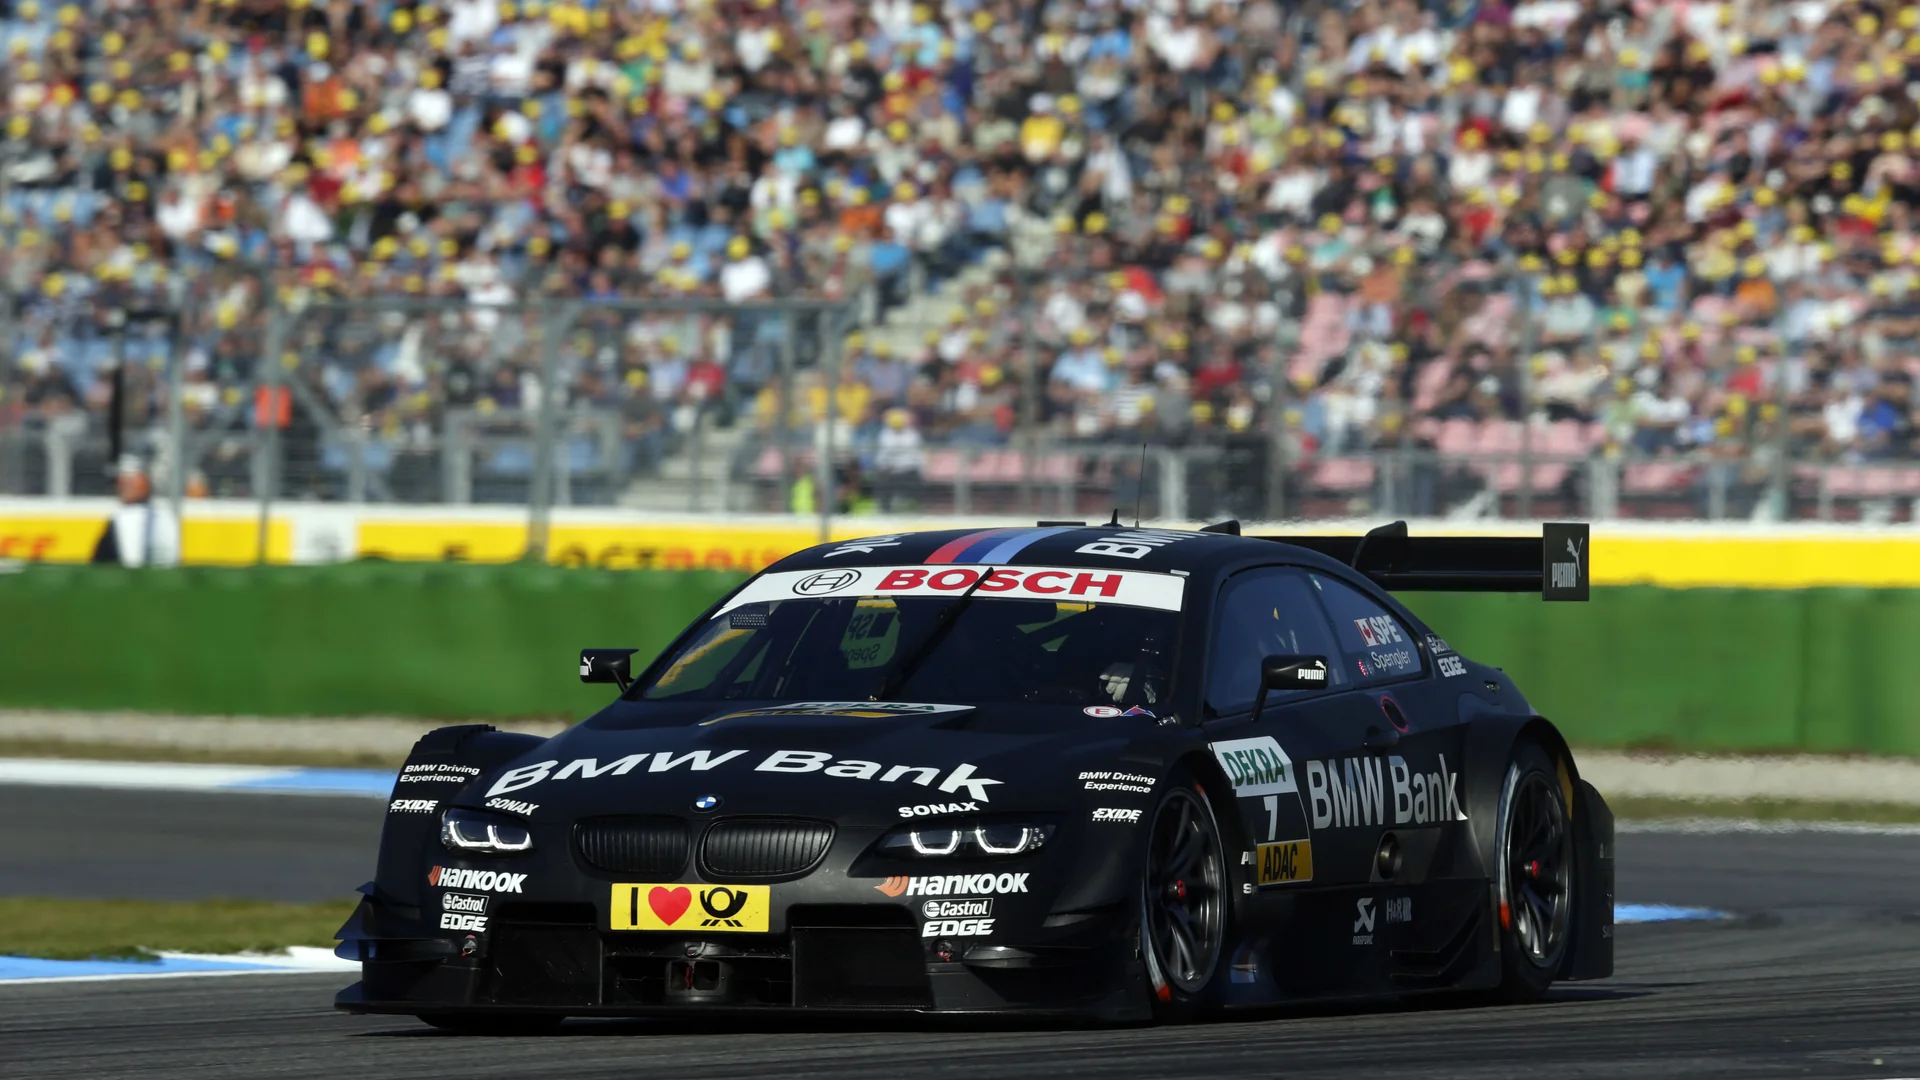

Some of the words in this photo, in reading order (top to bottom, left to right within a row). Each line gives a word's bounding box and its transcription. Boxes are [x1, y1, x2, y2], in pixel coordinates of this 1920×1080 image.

[875, 568, 1122, 597] BOSCH
[1552, 563, 1576, 588] PUMA
[1369, 614, 1402, 645] SPE
[1371, 648, 1412, 672] Spengler
[1437, 656, 1467, 677] EDGE
[1298, 669, 1324, 680] PUMA
[404, 764, 437, 774] BMW
[438, 765, 480, 776] Driving
[485, 749, 749, 798] BMW
[754, 750, 1005, 803] Bank
[1222, 746, 1287, 787] DEKRA
[400, 774, 465, 783] Experience
[1078, 772, 1112, 780] BMW
[1112, 772, 1156, 785] Driving
[1084, 781, 1151, 793] Experience
[1306, 757, 1384, 830] BMW
[1388, 753, 1468, 825] Bank
[390, 800, 439, 811] EXIDE
[485, 798, 539, 816] SONAX
[898, 802, 980, 818] SONAX
[1092, 808, 1143, 820] EXIDE
[1263, 795, 1278, 841] 7
[1262, 843, 1298, 882] ADAC
[451, 895, 486, 912] Castrol
[630, 887, 639, 926] I
[940, 901, 988, 916] Castrol
[440, 913, 489, 932] EDGE
[921, 918, 996, 937] EDGE
